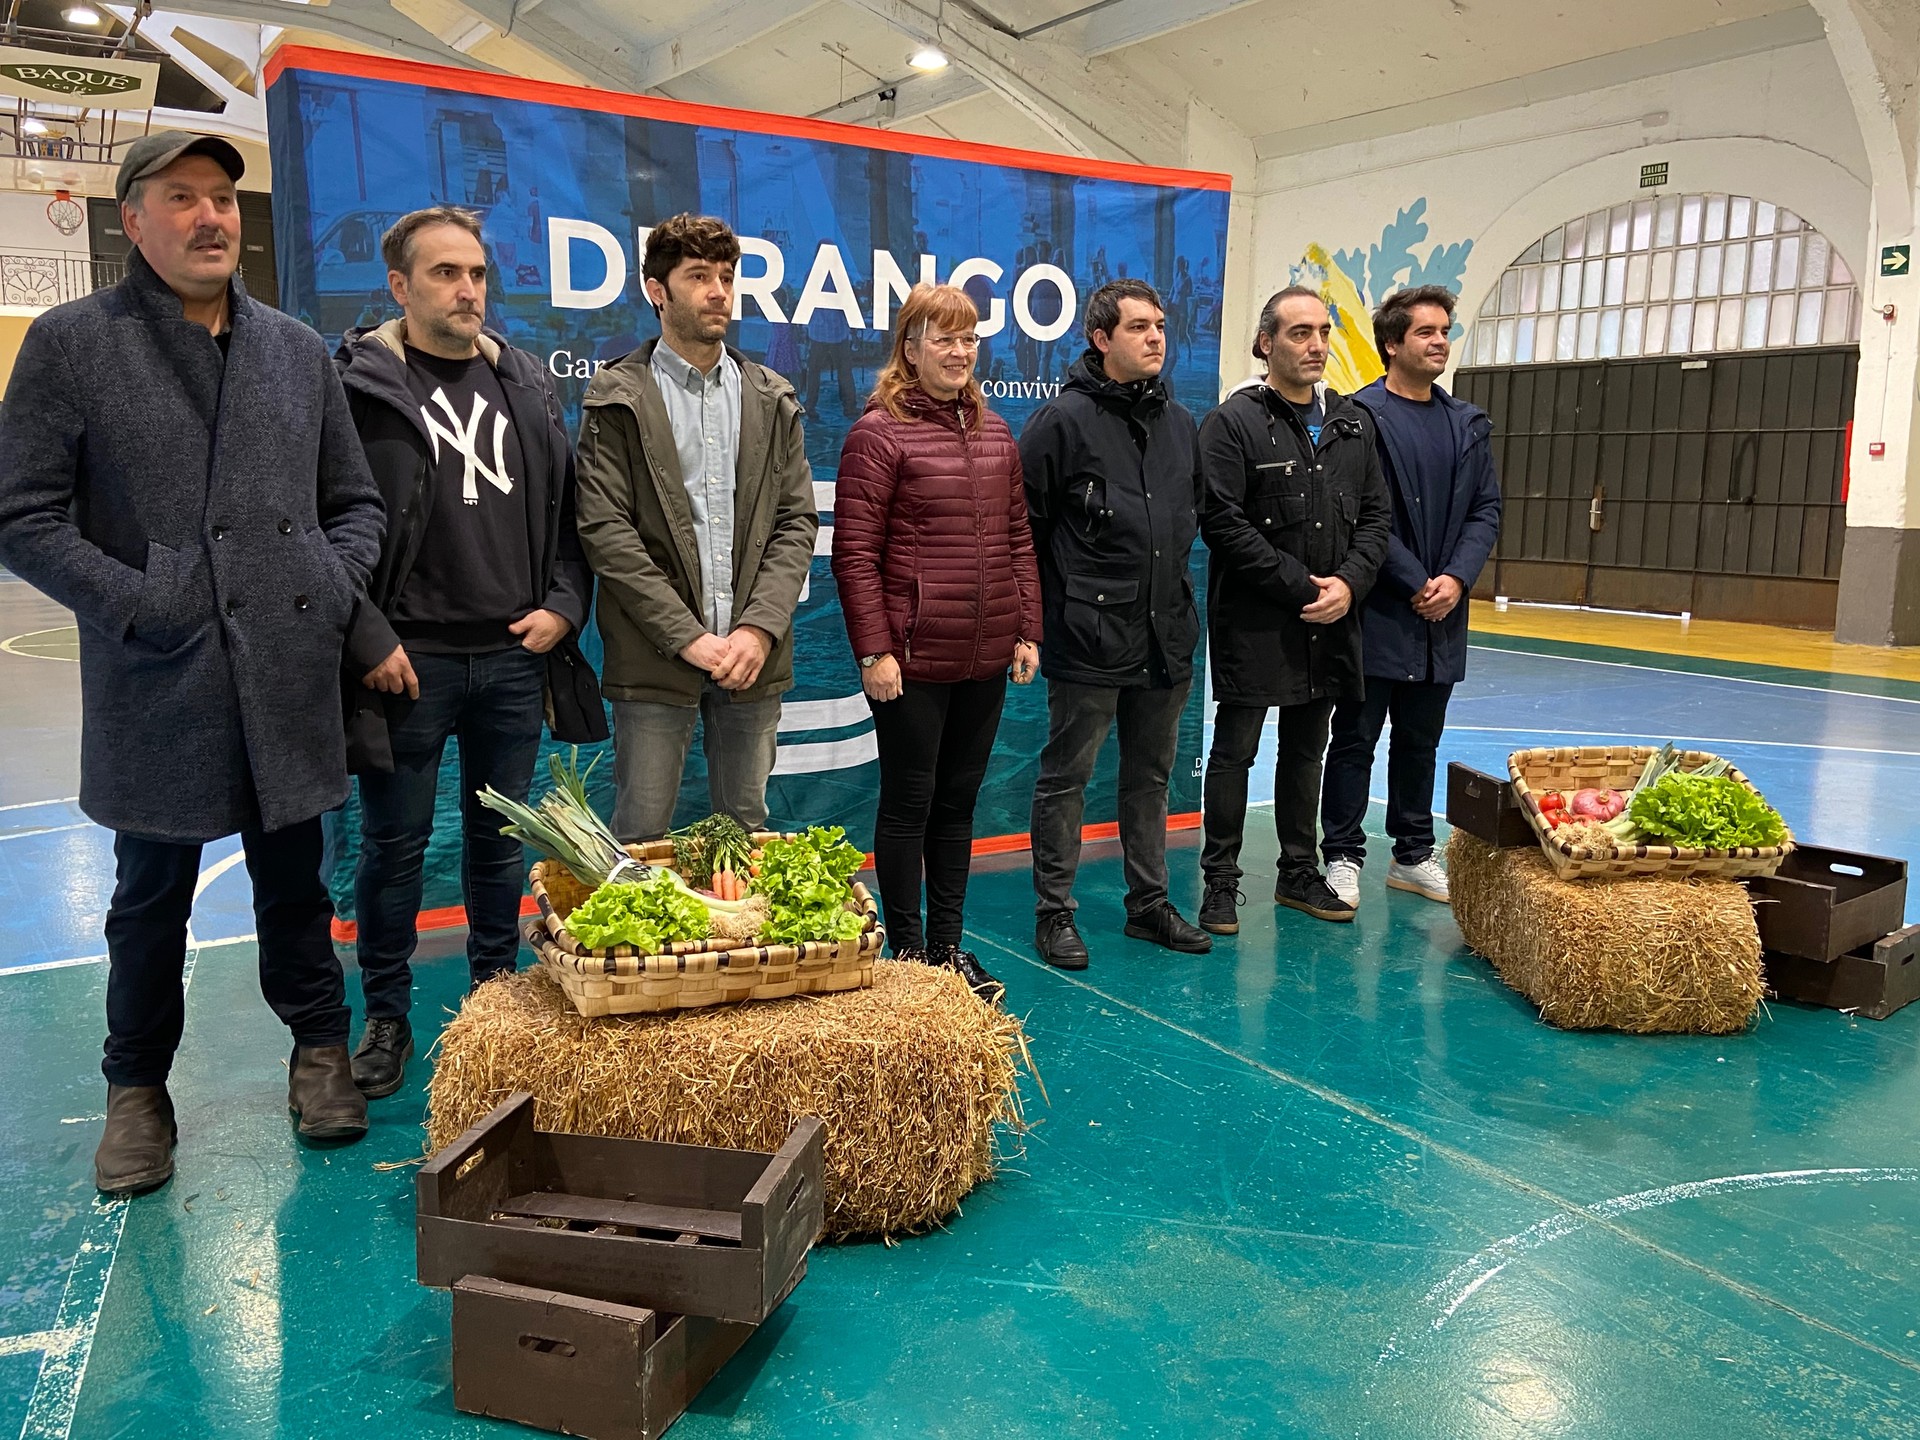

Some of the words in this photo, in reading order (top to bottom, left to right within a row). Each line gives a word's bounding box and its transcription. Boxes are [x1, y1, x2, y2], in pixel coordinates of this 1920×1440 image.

[15, 67, 129, 90] BAQUÉ
[1642, 164, 1666, 175] SALIDA
[980, 376, 1066, 400] convivi
[420, 386, 514, 495] NY
